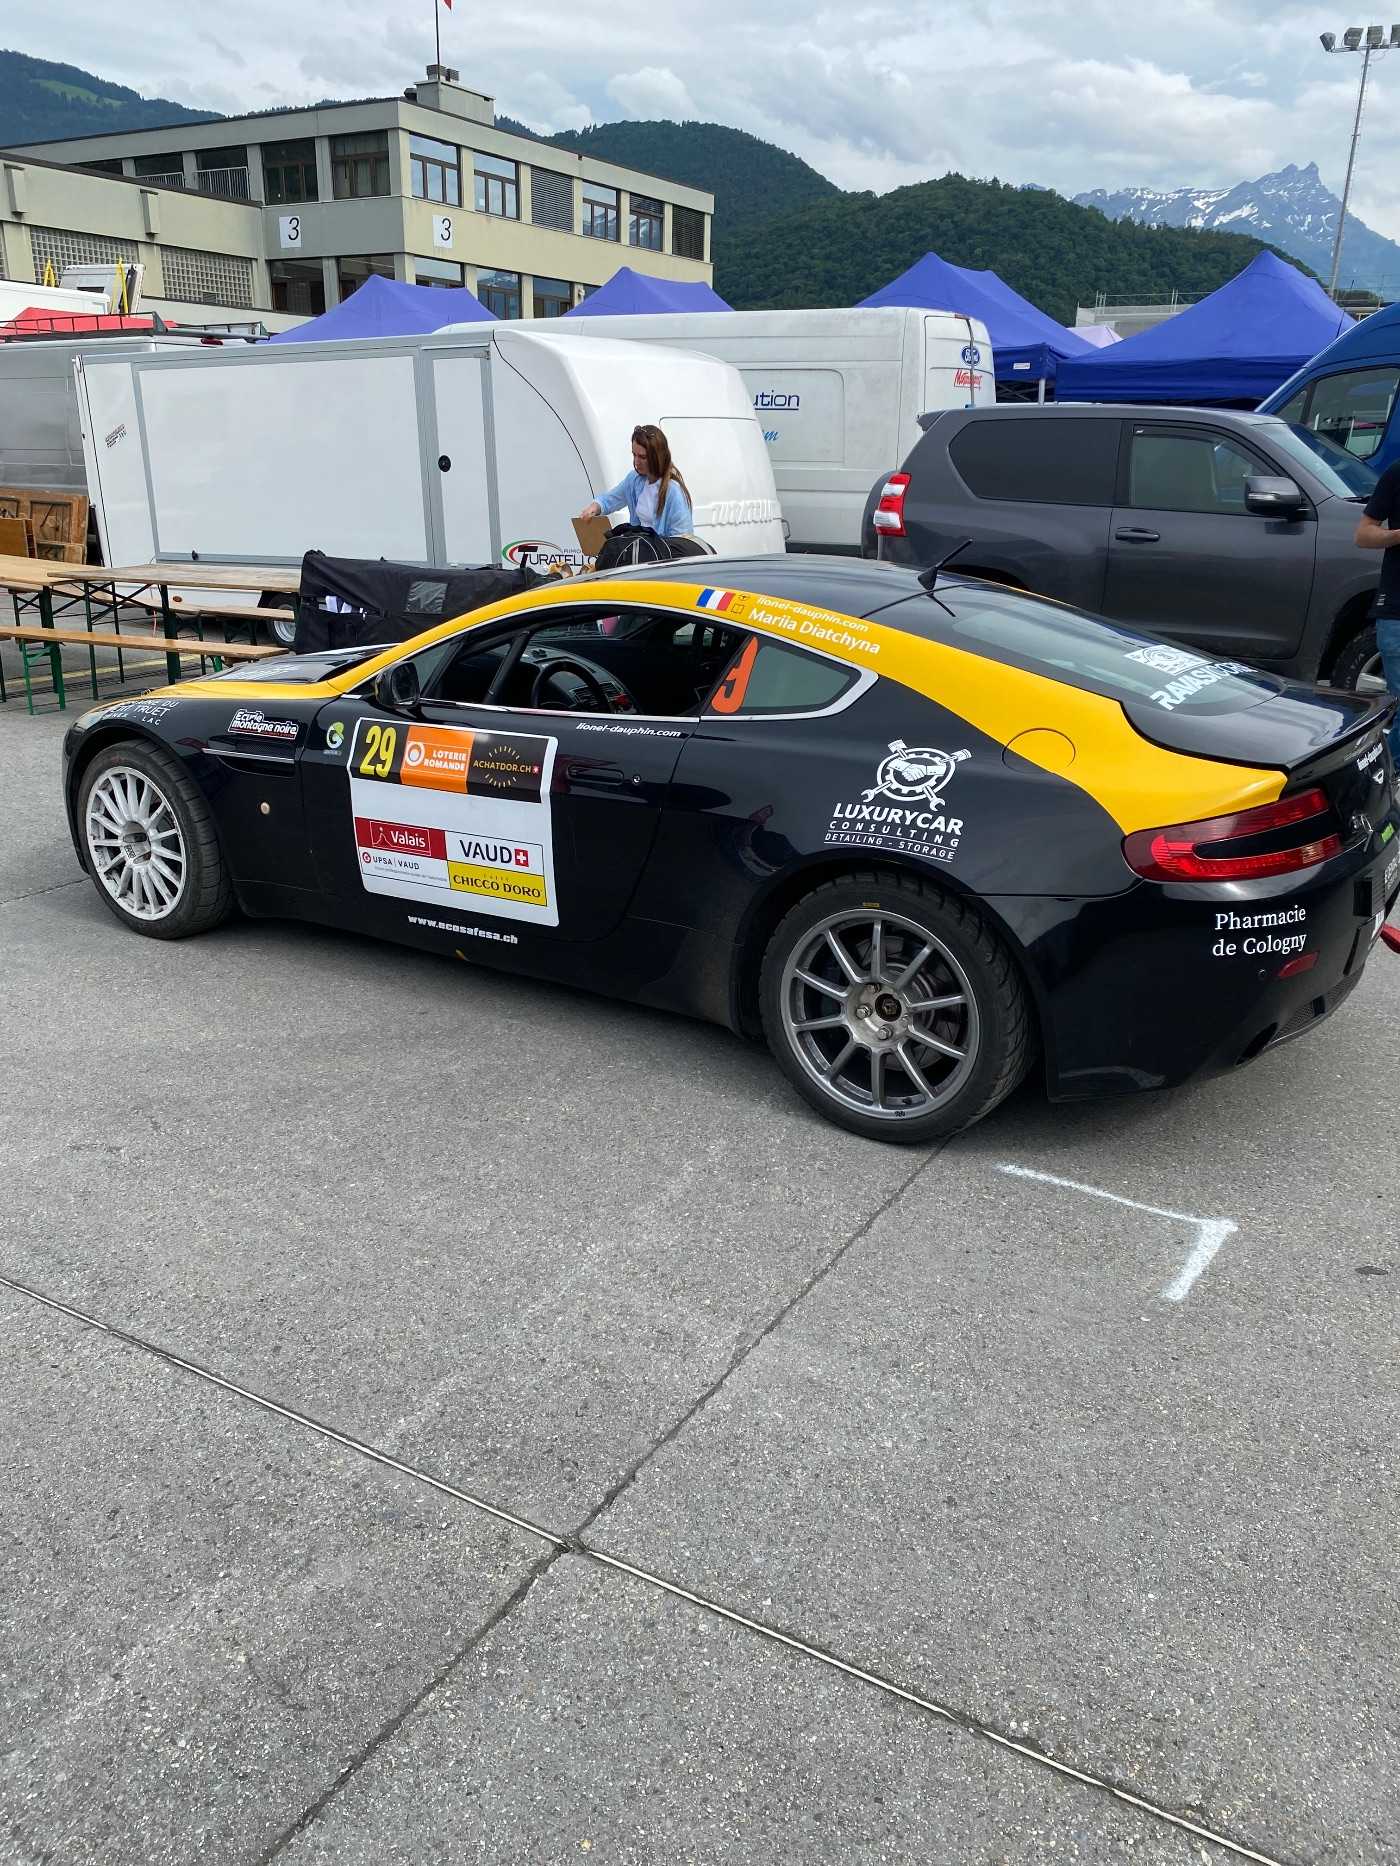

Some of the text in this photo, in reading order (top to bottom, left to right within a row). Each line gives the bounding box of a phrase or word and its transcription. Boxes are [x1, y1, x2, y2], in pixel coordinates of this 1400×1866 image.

[288, 217, 300, 241] 3
[440, 217, 452, 241] 3
[799, 620, 881, 655] Diatchyna
[232, 720, 274, 733] montagne
[274, 723, 297, 735] noire
[576, 722, 682, 737] lionel-dauphin.com
[359, 725, 397, 778] 29
[432, 750, 467, 761] LOTERIE
[423, 759, 466, 772] ROMANDE
[473, 759, 532, 773] ACHATDOR.CH
[833, 802, 964, 836] LUXURYCAR
[390, 830, 427, 848] Valais
[825, 832, 883, 846] DETAILING
[898, 840, 956, 860] STORAGE
[829, 820, 960, 848] CONSULTING
[372, 855, 420, 870] UPSA VAUD
[459, 840, 512, 864] VAUD
[453, 874, 500, 891] CHICCO
[1214, 904, 1306, 931] Pharmacie
[407, 915, 519, 945] www.ecosafesa.ch
[1212, 933, 1307, 956] de Cologny
